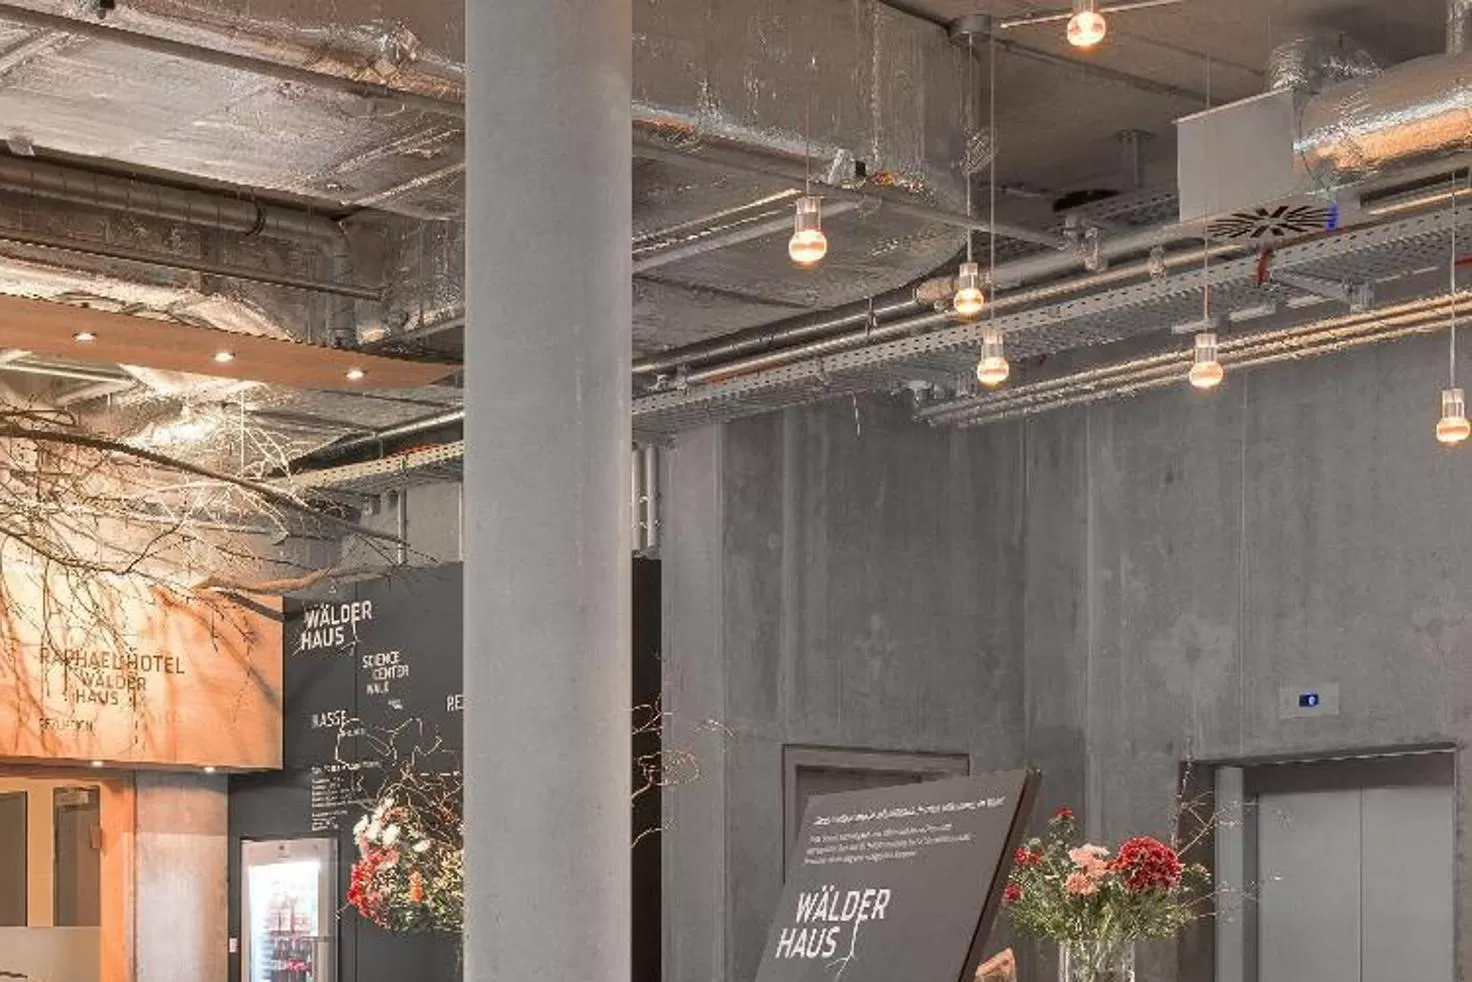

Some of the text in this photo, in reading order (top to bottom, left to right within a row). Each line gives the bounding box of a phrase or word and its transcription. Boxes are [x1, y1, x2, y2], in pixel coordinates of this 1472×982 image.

[300, 627, 345, 651] HAUS
[795, 884, 891, 923] WÄLDER
[774, 925, 841, 959] HAUS
